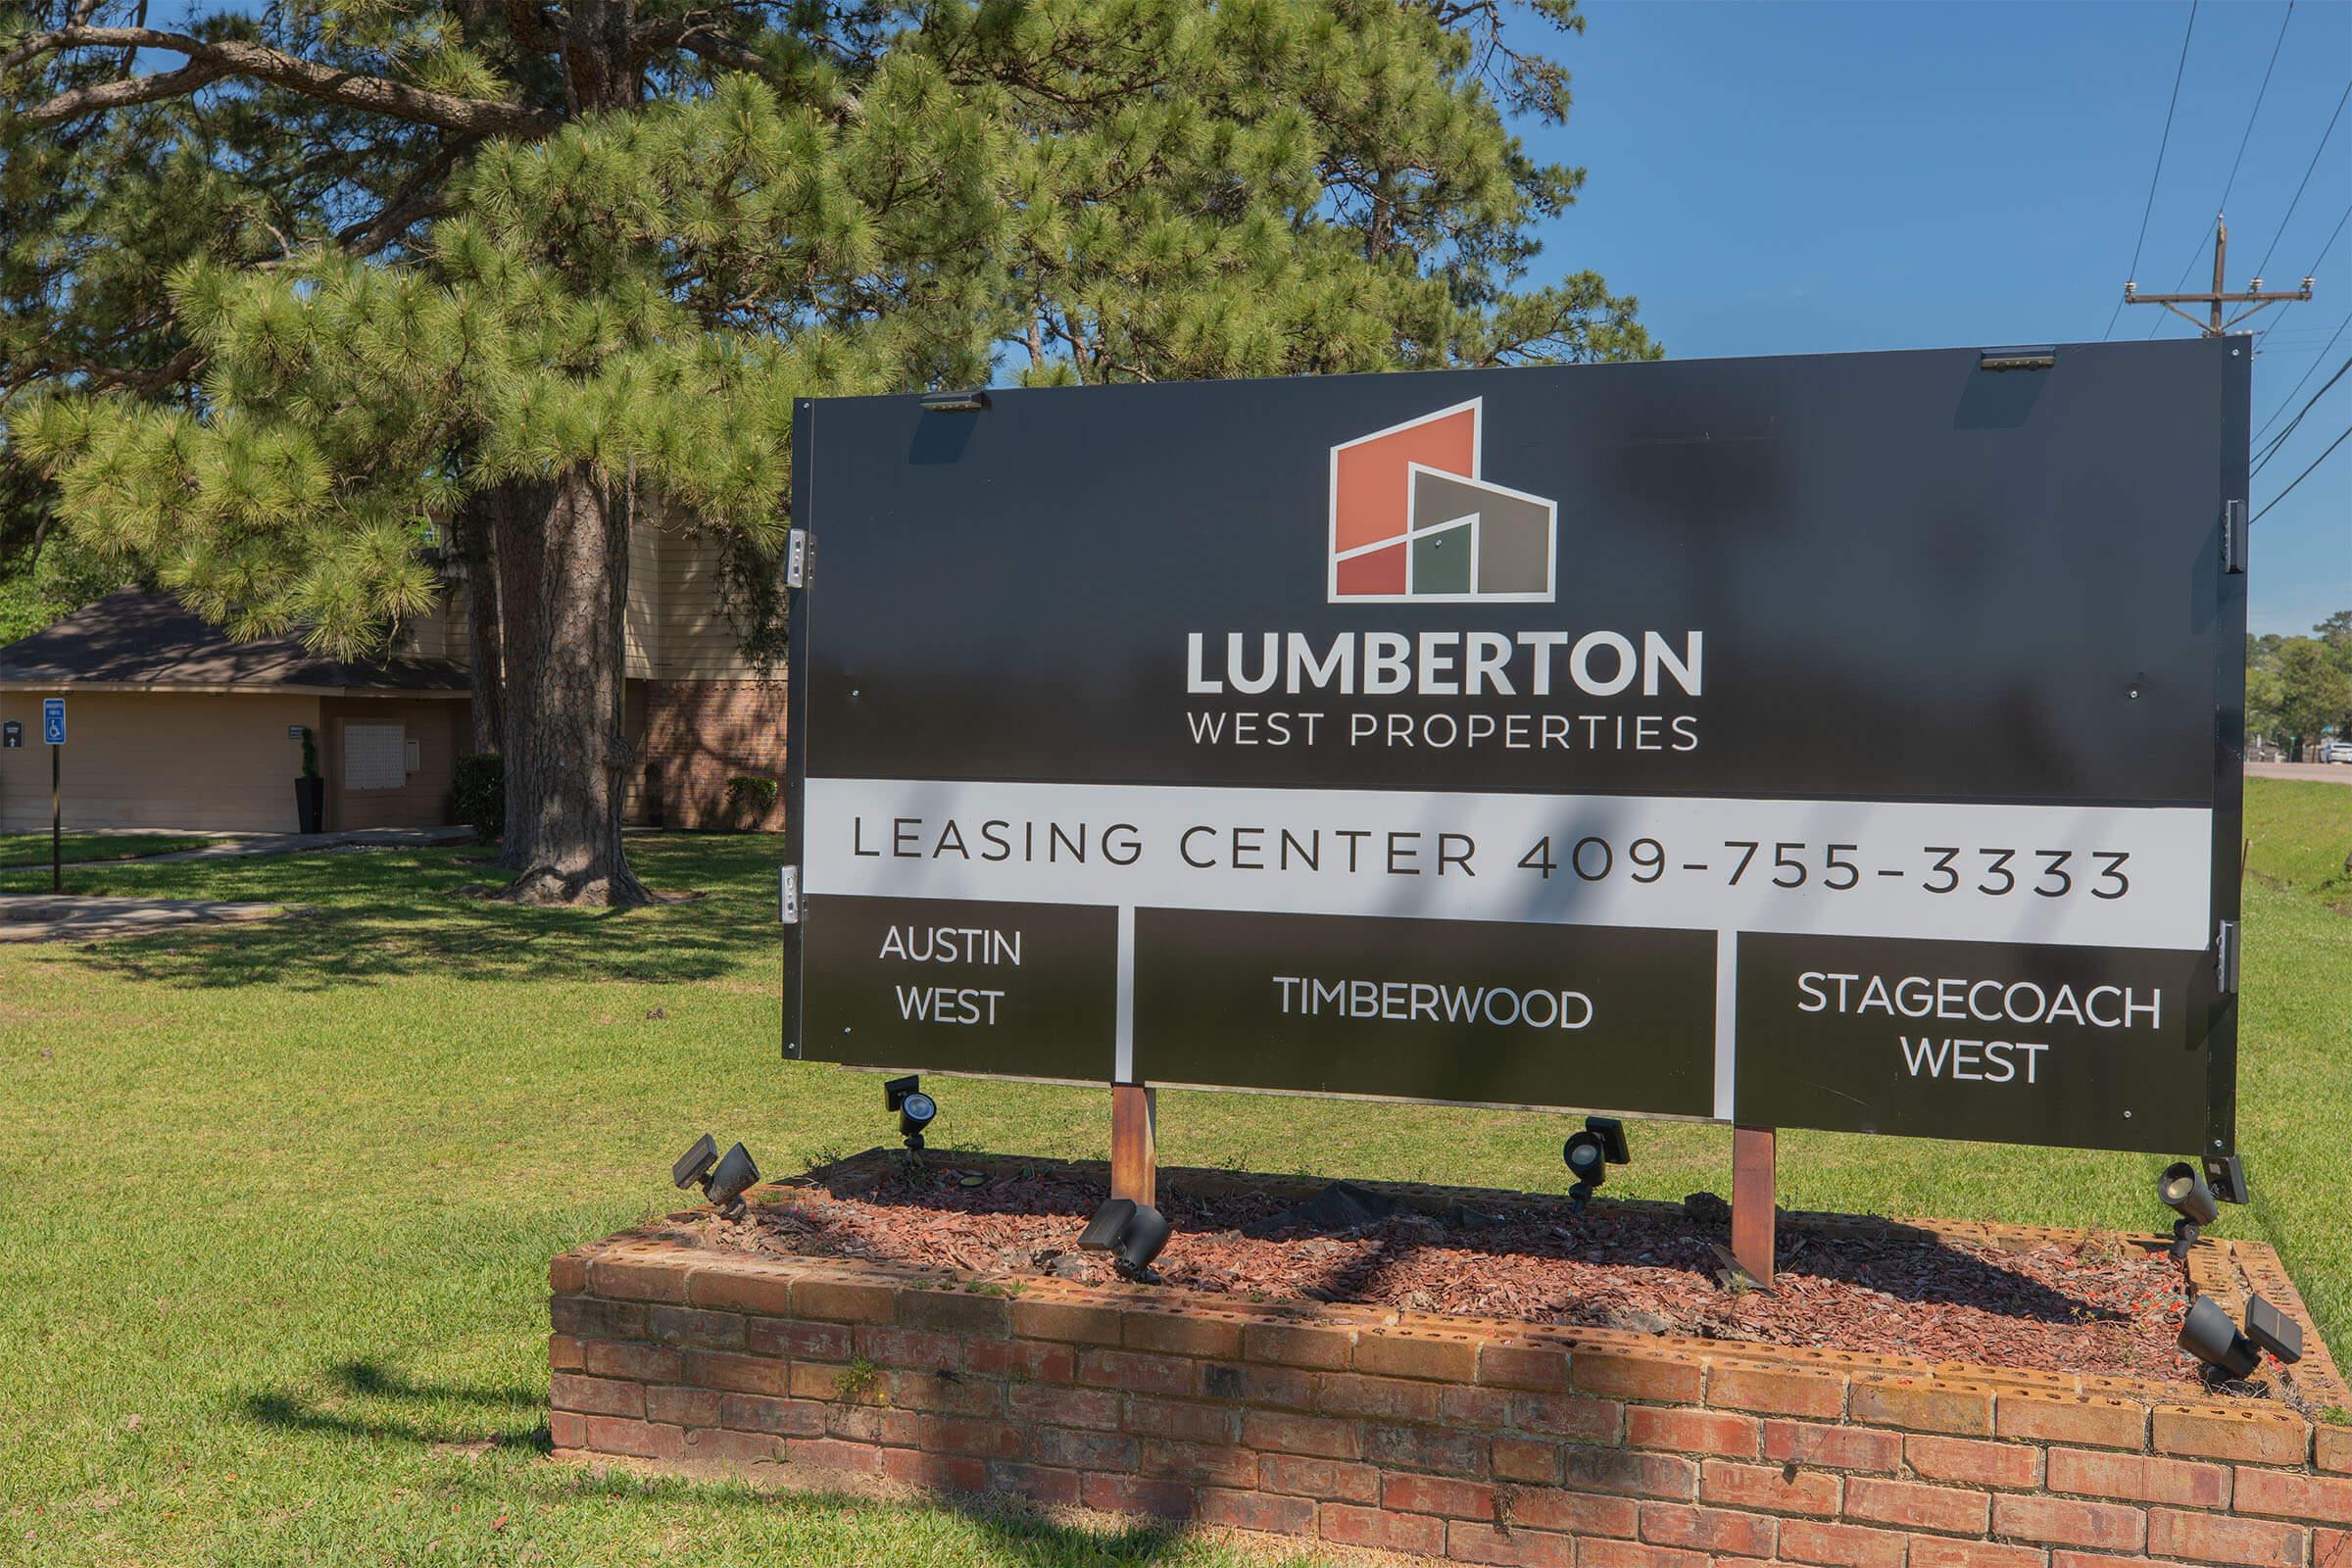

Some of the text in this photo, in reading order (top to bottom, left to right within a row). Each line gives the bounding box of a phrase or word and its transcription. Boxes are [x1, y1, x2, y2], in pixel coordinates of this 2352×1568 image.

[1187, 630, 1703, 697] LUMBERTON
[1187, 711, 1698, 752] WEST PROPERTIES
[854, 816, 2131, 901] LEASING CENTER 409-755-3333
[878, 924, 1021, 966] AUSTIN
[895, 985, 1005, 1025] WEST
[1272, 976, 1593, 1029] TIMBERWOOD
[1797, 971, 2161, 1030] STAGECOACH
[1899, 1036, 2050, 1084] WEST
